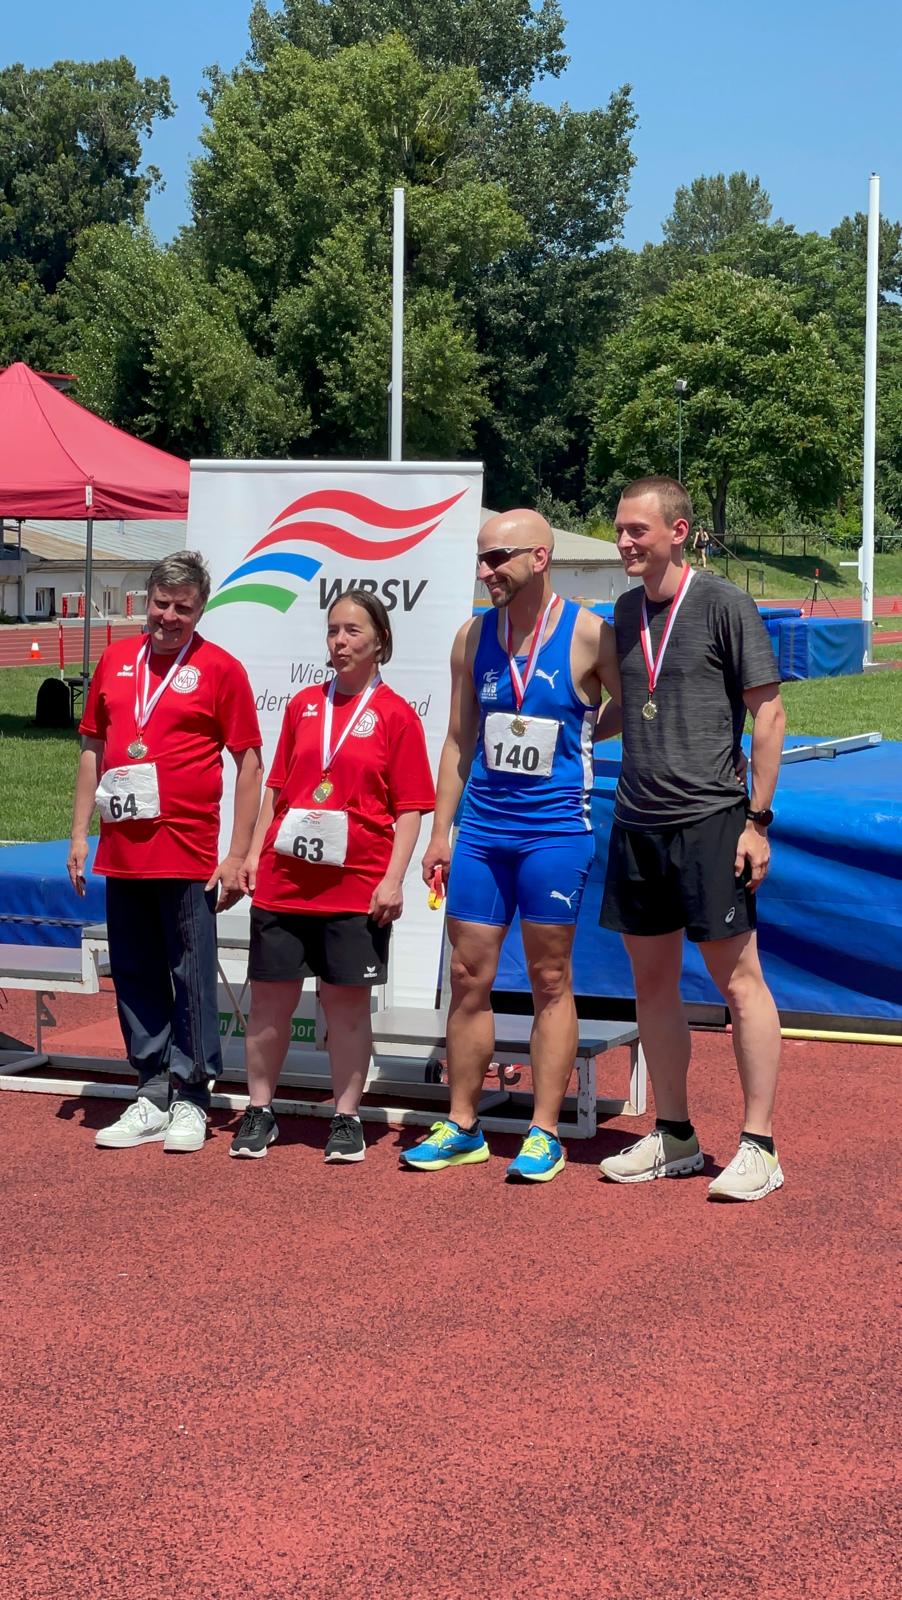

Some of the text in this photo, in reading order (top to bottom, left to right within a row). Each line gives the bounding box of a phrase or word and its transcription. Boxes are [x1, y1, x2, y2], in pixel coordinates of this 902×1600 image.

[290, 663, 335, 684] Wien
[493, 742, 540, 771] 140
[109, 793, 138, 819] 64
[292, 835, 324, 862] 63
